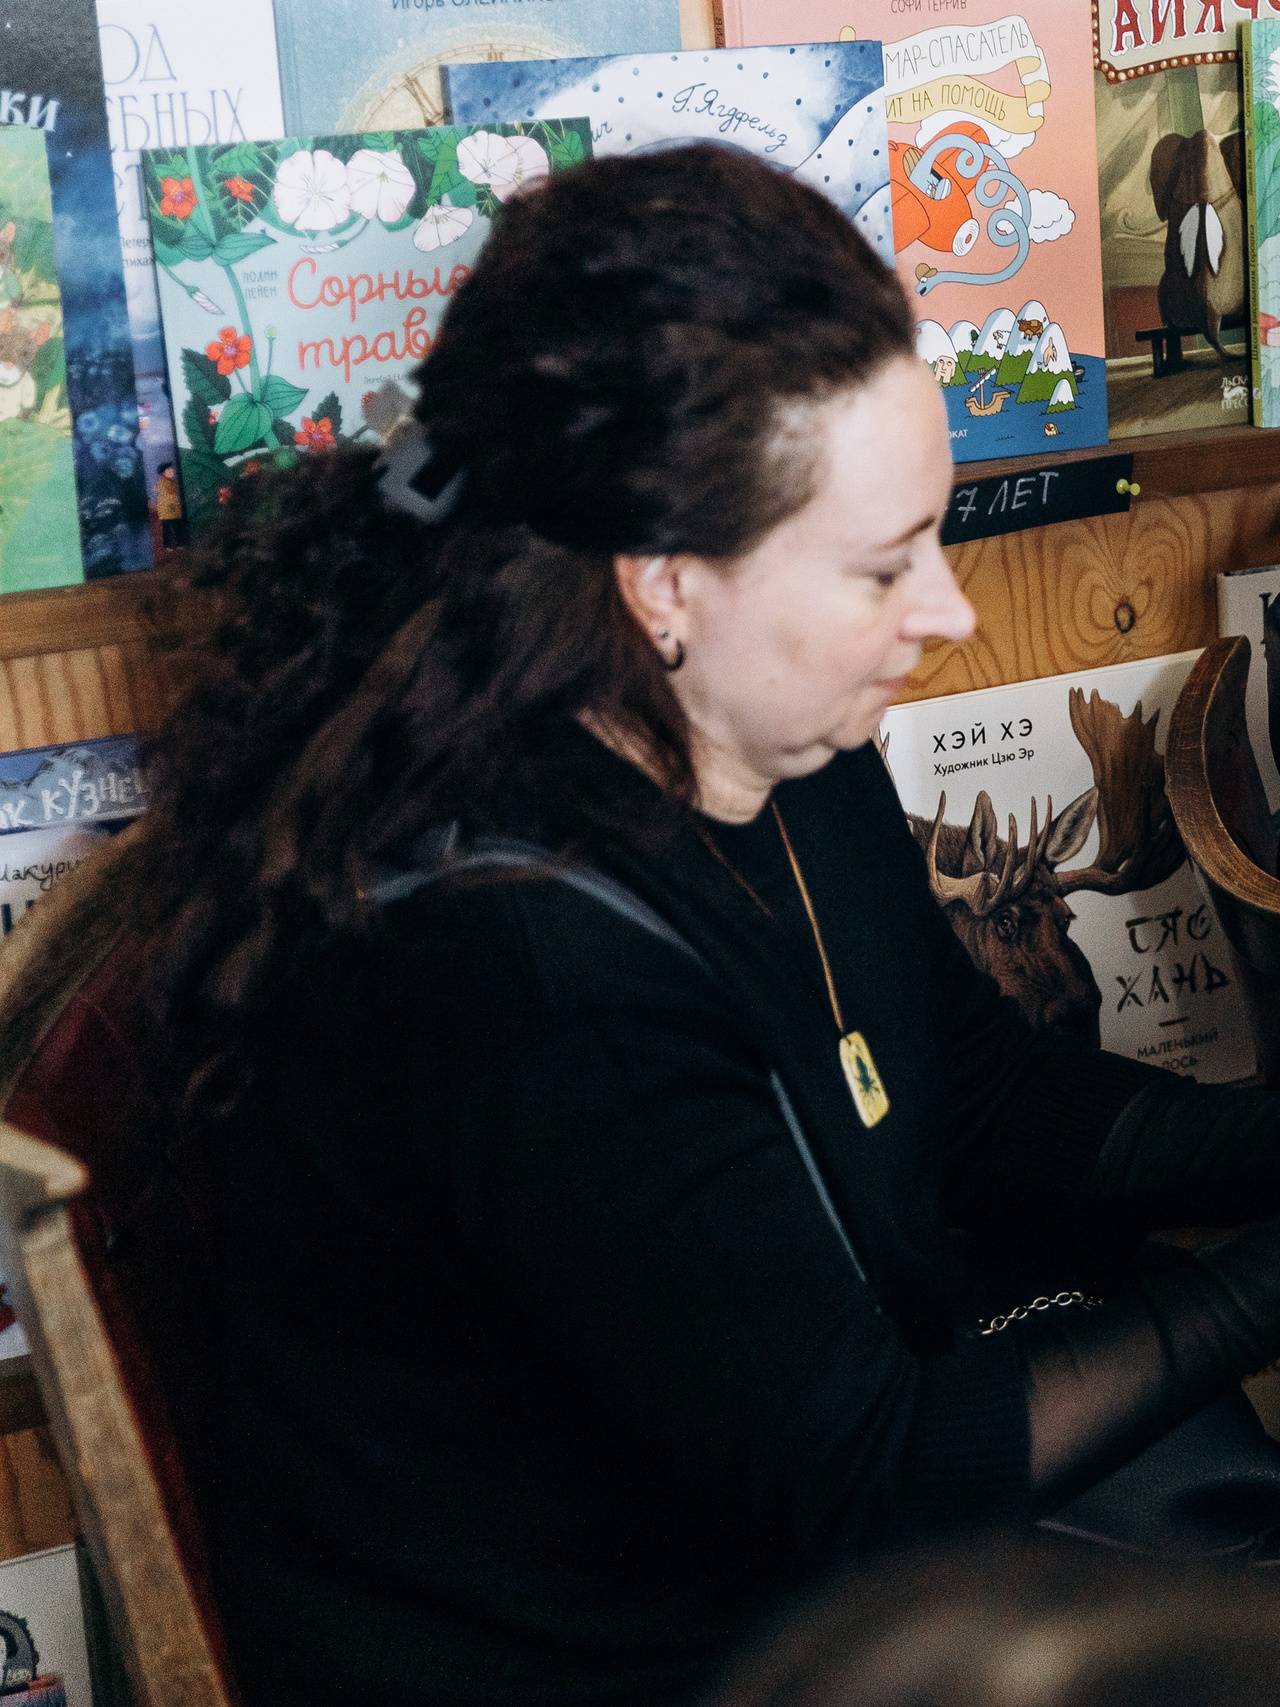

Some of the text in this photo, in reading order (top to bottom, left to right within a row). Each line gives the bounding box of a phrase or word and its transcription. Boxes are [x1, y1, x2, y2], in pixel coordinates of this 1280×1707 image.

[106, 88, 250, 153] БНЫХ
[912, 90, 933, 113] НА
[941, 84, 1006, 121] ПОМОЩЬ
[299, 306, 442, 384] трав
[988, 471, 1059, 515] ЛЕТ
[932, 718, 1033, 753] ХЭЙ ХЭ
[933, 747, 1035, 777] Художник Цзю Эр
[1115, 954, 1229, 1014] ХАНЬ
[1136, 1028, 1219, 1059] МАЛЕНЬКИЙ
